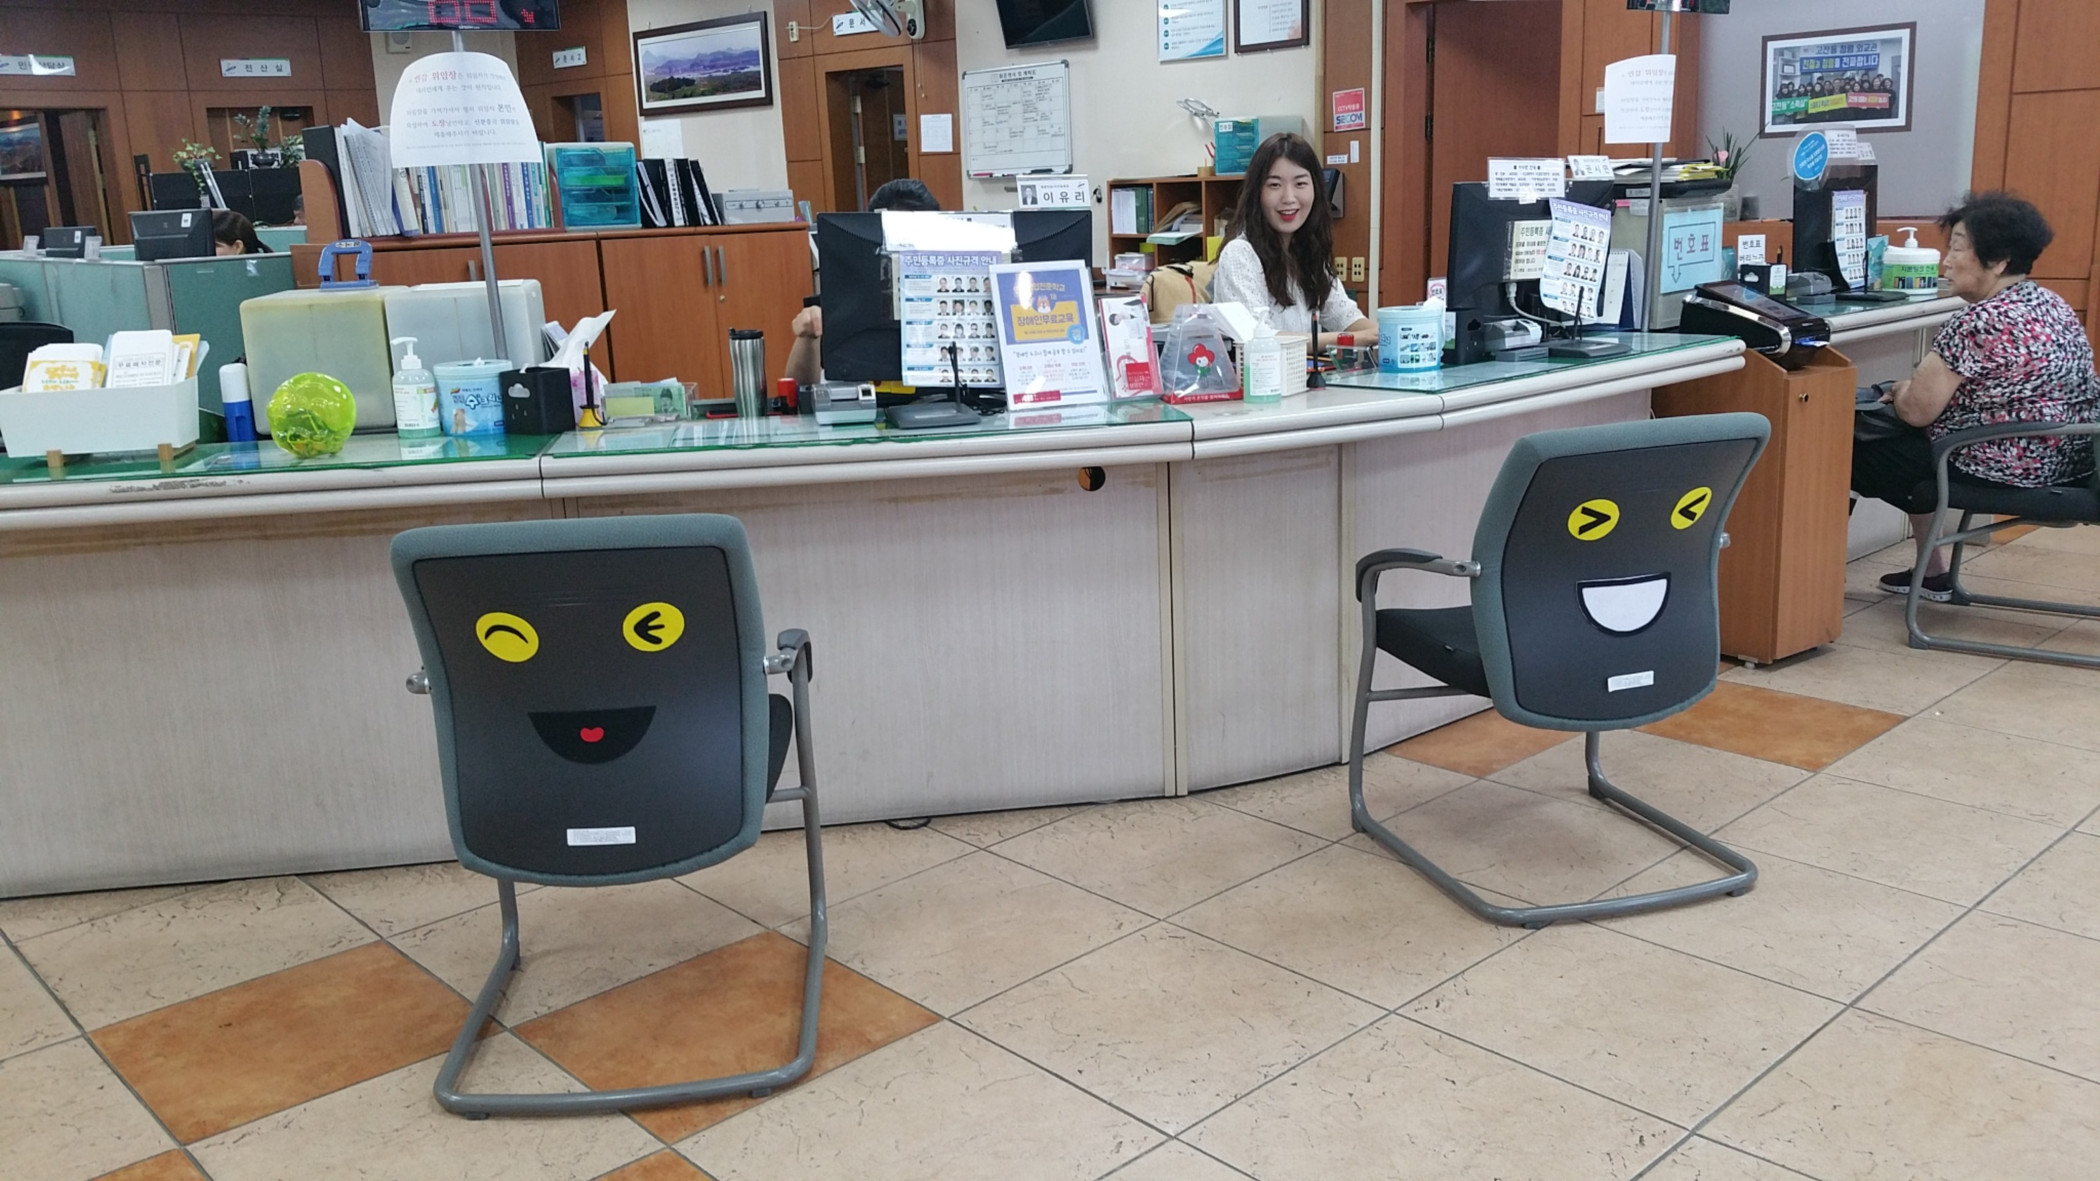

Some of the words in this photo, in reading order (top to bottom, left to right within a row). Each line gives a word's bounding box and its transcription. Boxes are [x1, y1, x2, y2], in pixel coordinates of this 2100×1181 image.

[1336, 113, 1363, 125] SECOM
[904, 255, 944, 267] 주민등록증
[946, 255, 979, 266] 사진규격
[980, 255, 997, 265] 안내
